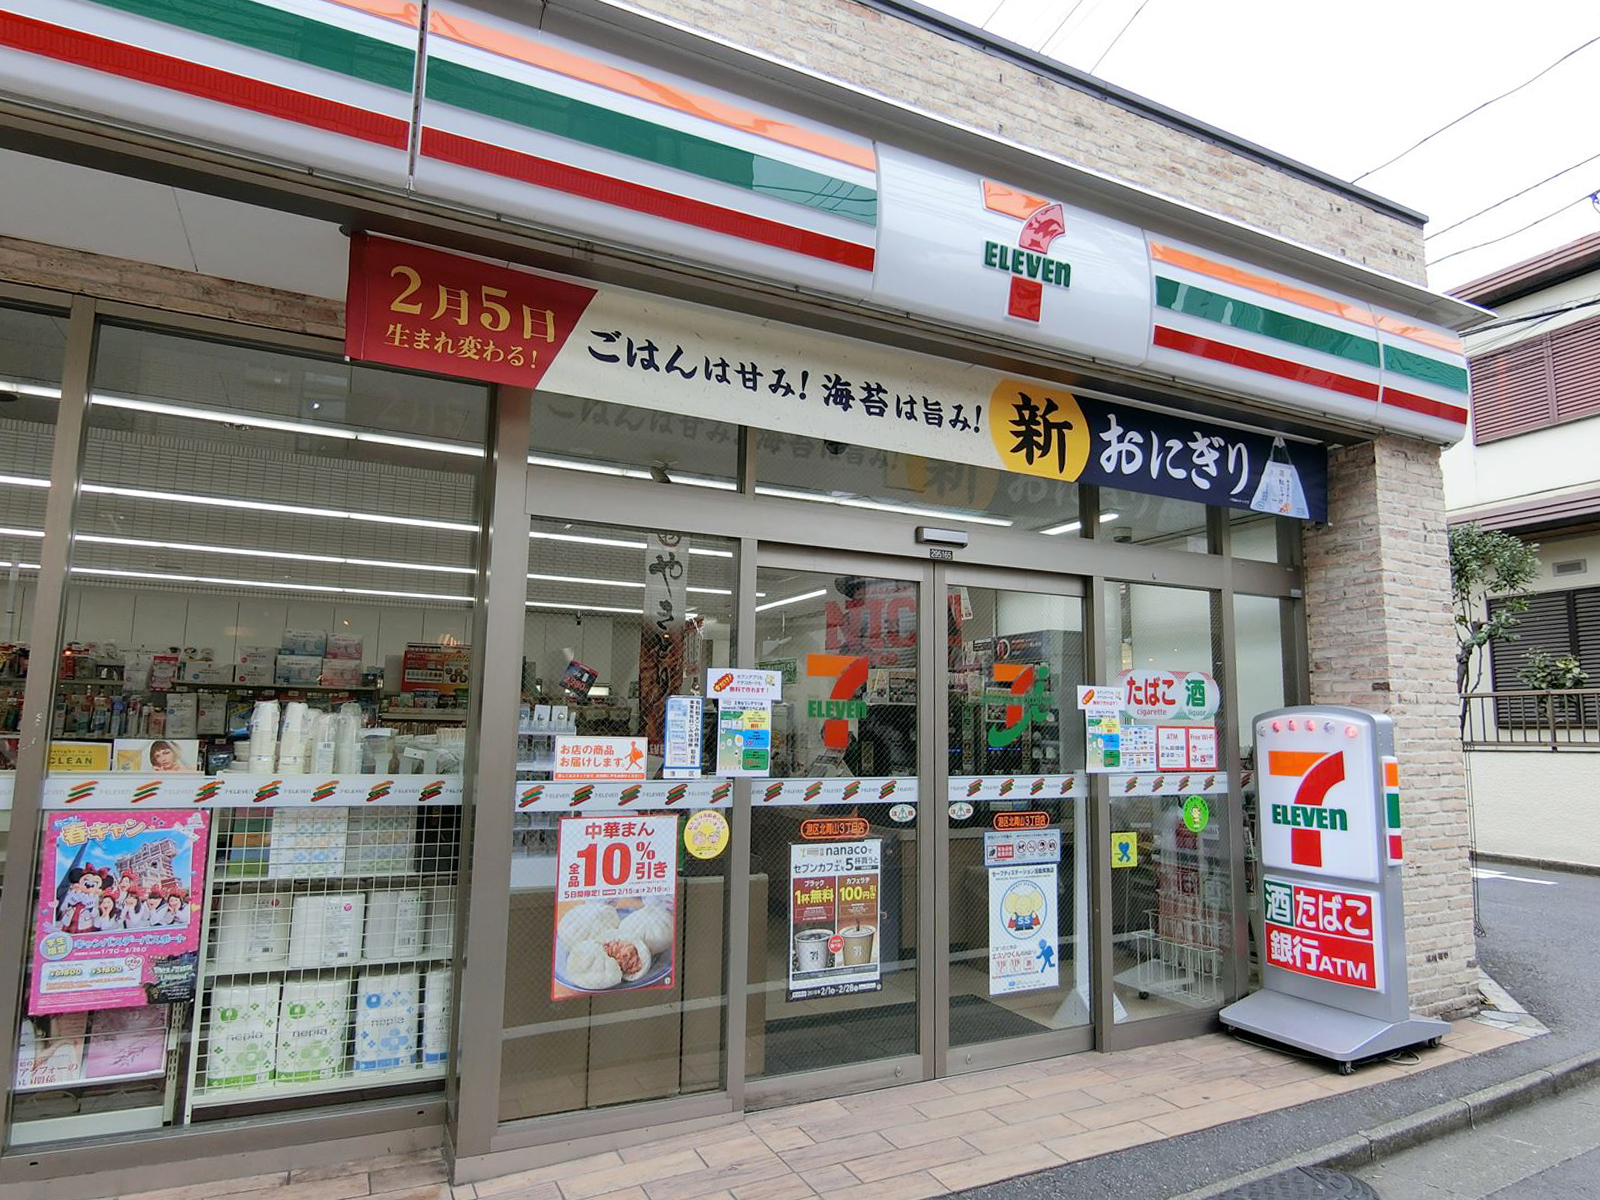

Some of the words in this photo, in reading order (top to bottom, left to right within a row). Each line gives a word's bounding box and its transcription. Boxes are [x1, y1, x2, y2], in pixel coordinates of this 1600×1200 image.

[389, 265, 556, 343] 2月5日
[1008, 392, 1074, 474] 新
[1099, 413, 1249, 495] おにぎり
[1126, 675, 1176, 707] たばこ
[1185, 678, 1206, 707] 酒
[1136, 708, 1168, 717] cigarette
[1188, 709, 1207, 717] liquor
[49, 756, 93, 765] CLEAN
[560, 744, 615, 756] お店の商品
[585, 822, 655, 840] 中華まん
[1265, 883, 1292, 924] 酒
[1294, 889, 1370, 936] たばこ
[292, 1028, 328, 1038] nepia
